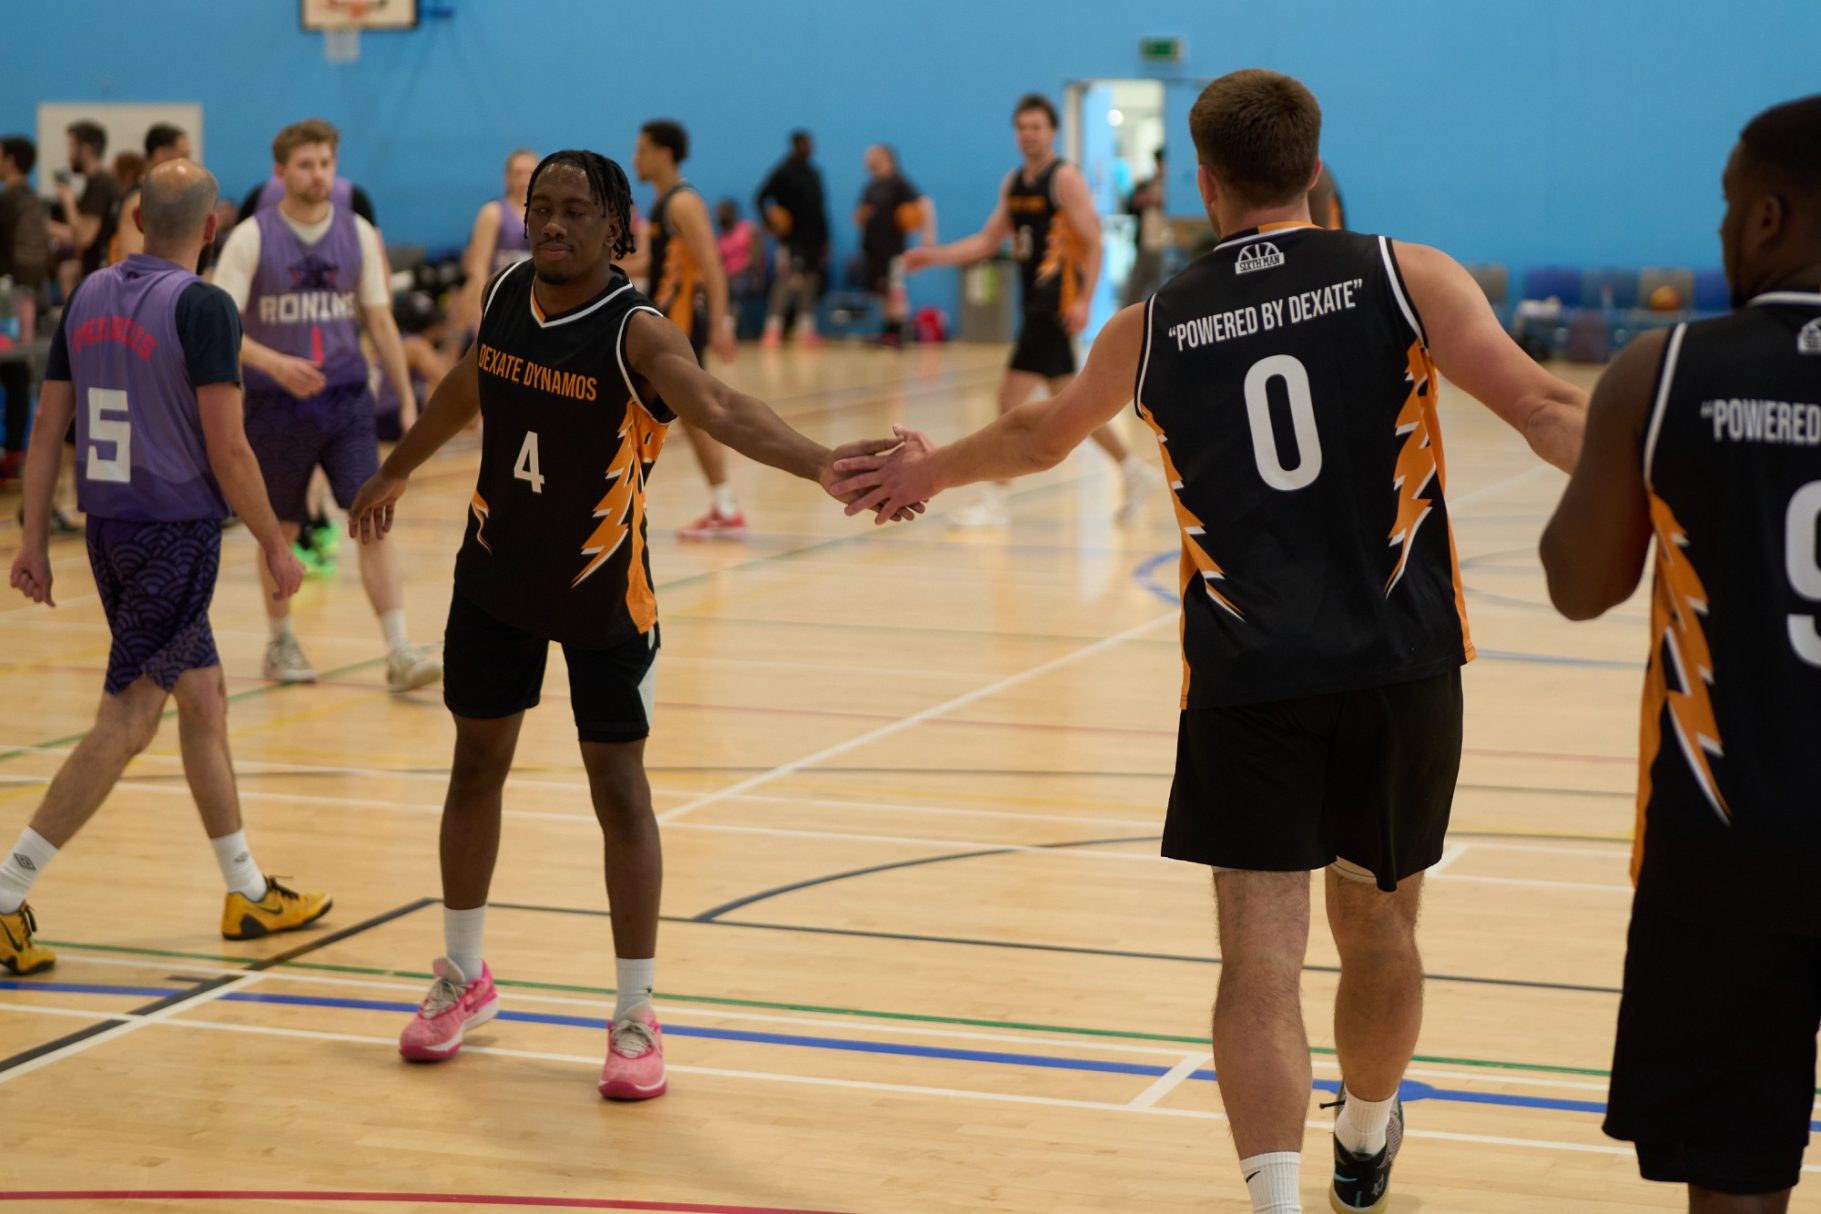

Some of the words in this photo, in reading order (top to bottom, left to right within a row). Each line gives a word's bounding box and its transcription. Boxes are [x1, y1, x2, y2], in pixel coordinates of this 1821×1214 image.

[1239, 257, 1262, 272] SIXTH
[1263, 254, 1280, 267] MAN
[1261, 299, 1284, 331] BY
[479, 343, 524, 383] DEXATE
[523, 361, 598, 401] DYNAMOS
[86, 387, 131, 483] 5
[1244, 354, 1323, 491] 0
[513, 430, 545, 494] 4
